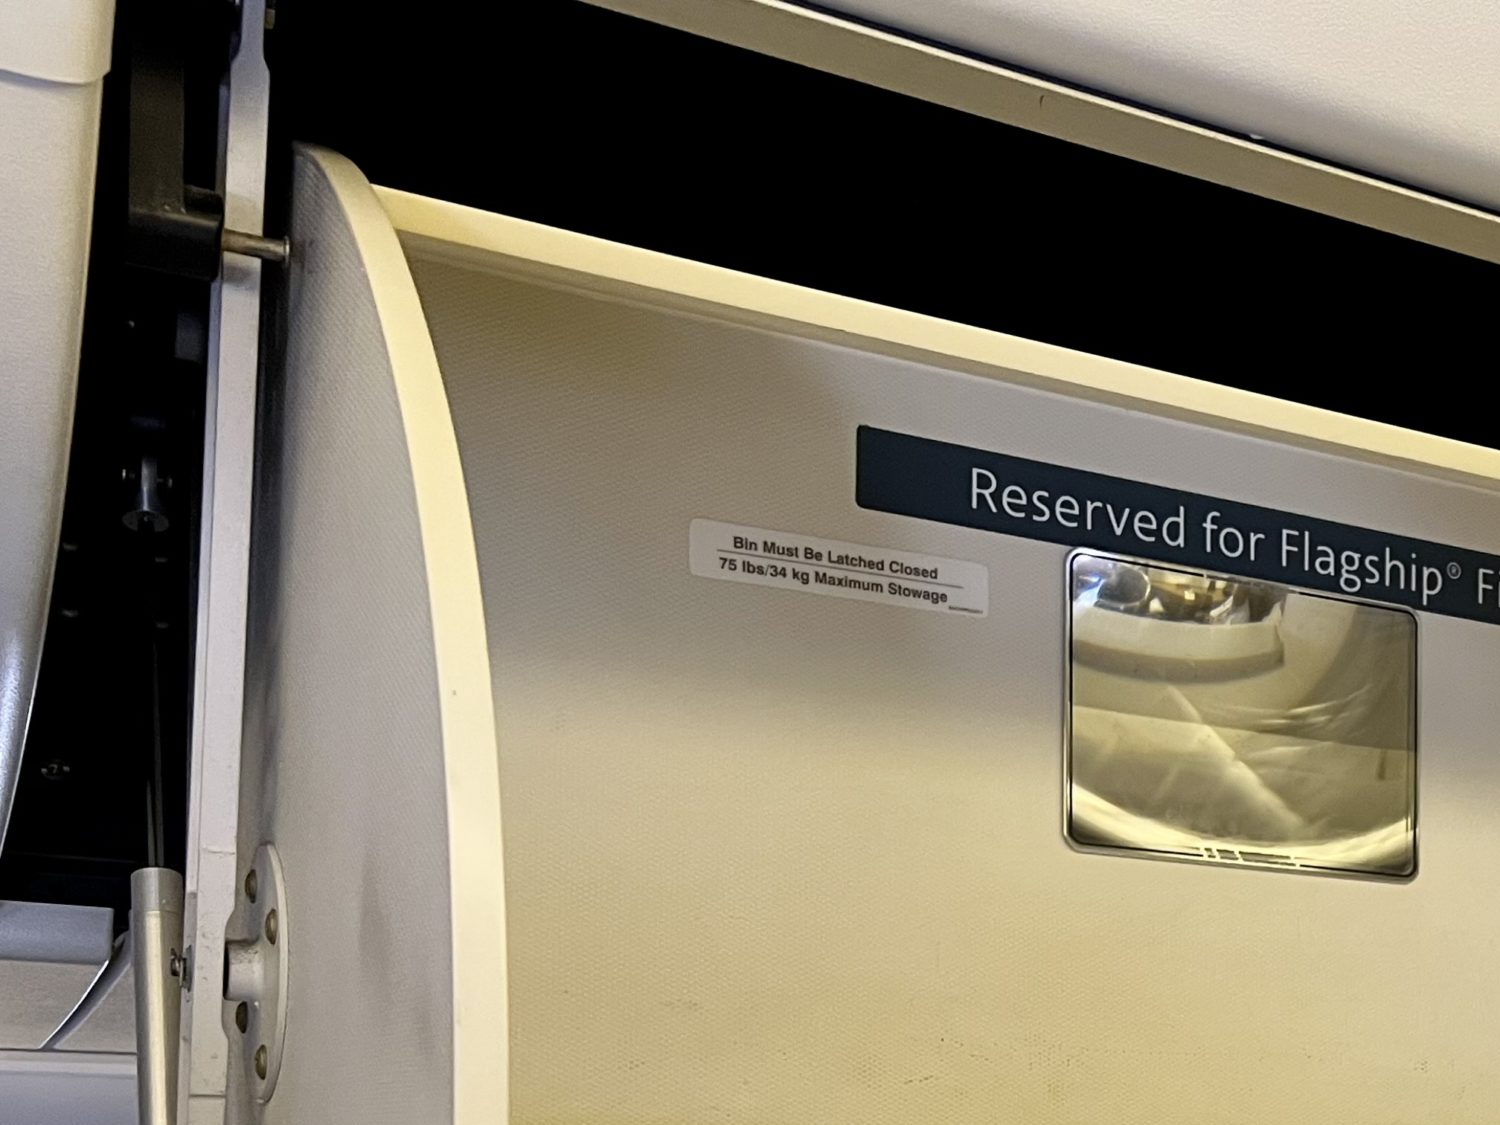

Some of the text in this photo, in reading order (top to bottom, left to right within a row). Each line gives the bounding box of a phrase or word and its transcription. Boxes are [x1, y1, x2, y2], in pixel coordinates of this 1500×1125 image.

[970, 466, 1186, 549] Reserved
[1201, 510, 1266, 559] for
[718, 556, 949, 605] 75 lbs/34 kg Maximum Stowage
[732, 535, 939, 580] Bin Must Be Latched Closed
